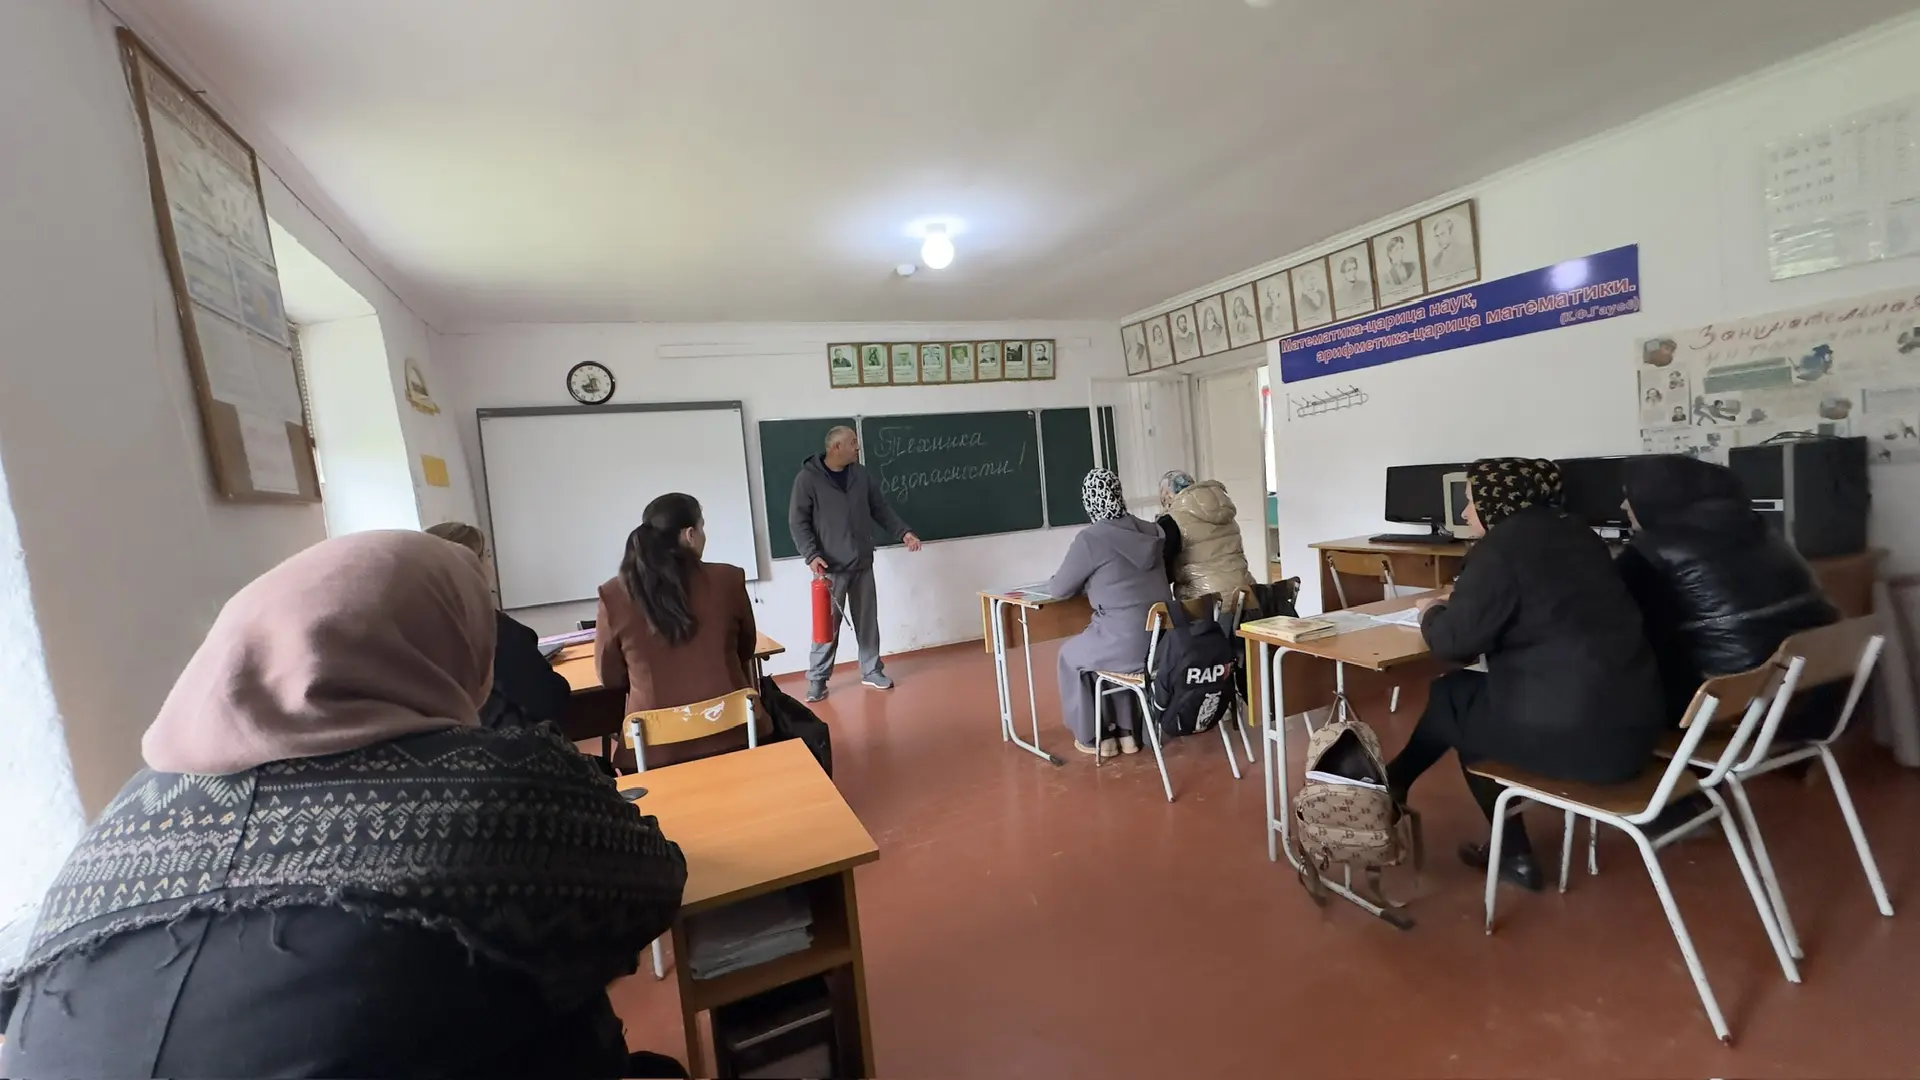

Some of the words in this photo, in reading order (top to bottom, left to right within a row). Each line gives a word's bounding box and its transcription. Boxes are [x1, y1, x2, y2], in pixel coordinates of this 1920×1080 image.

[1281, 307, 1426, 353] Математика-царица
[1429, 293, 1477, 316] наук,
[1316, 314, 1481, 364] арифметика-царица
[1486, 278, 1636, 324] математики.
[874, 426, 986, 457] Техника
[1186, 664, 1225, 685] RAP
